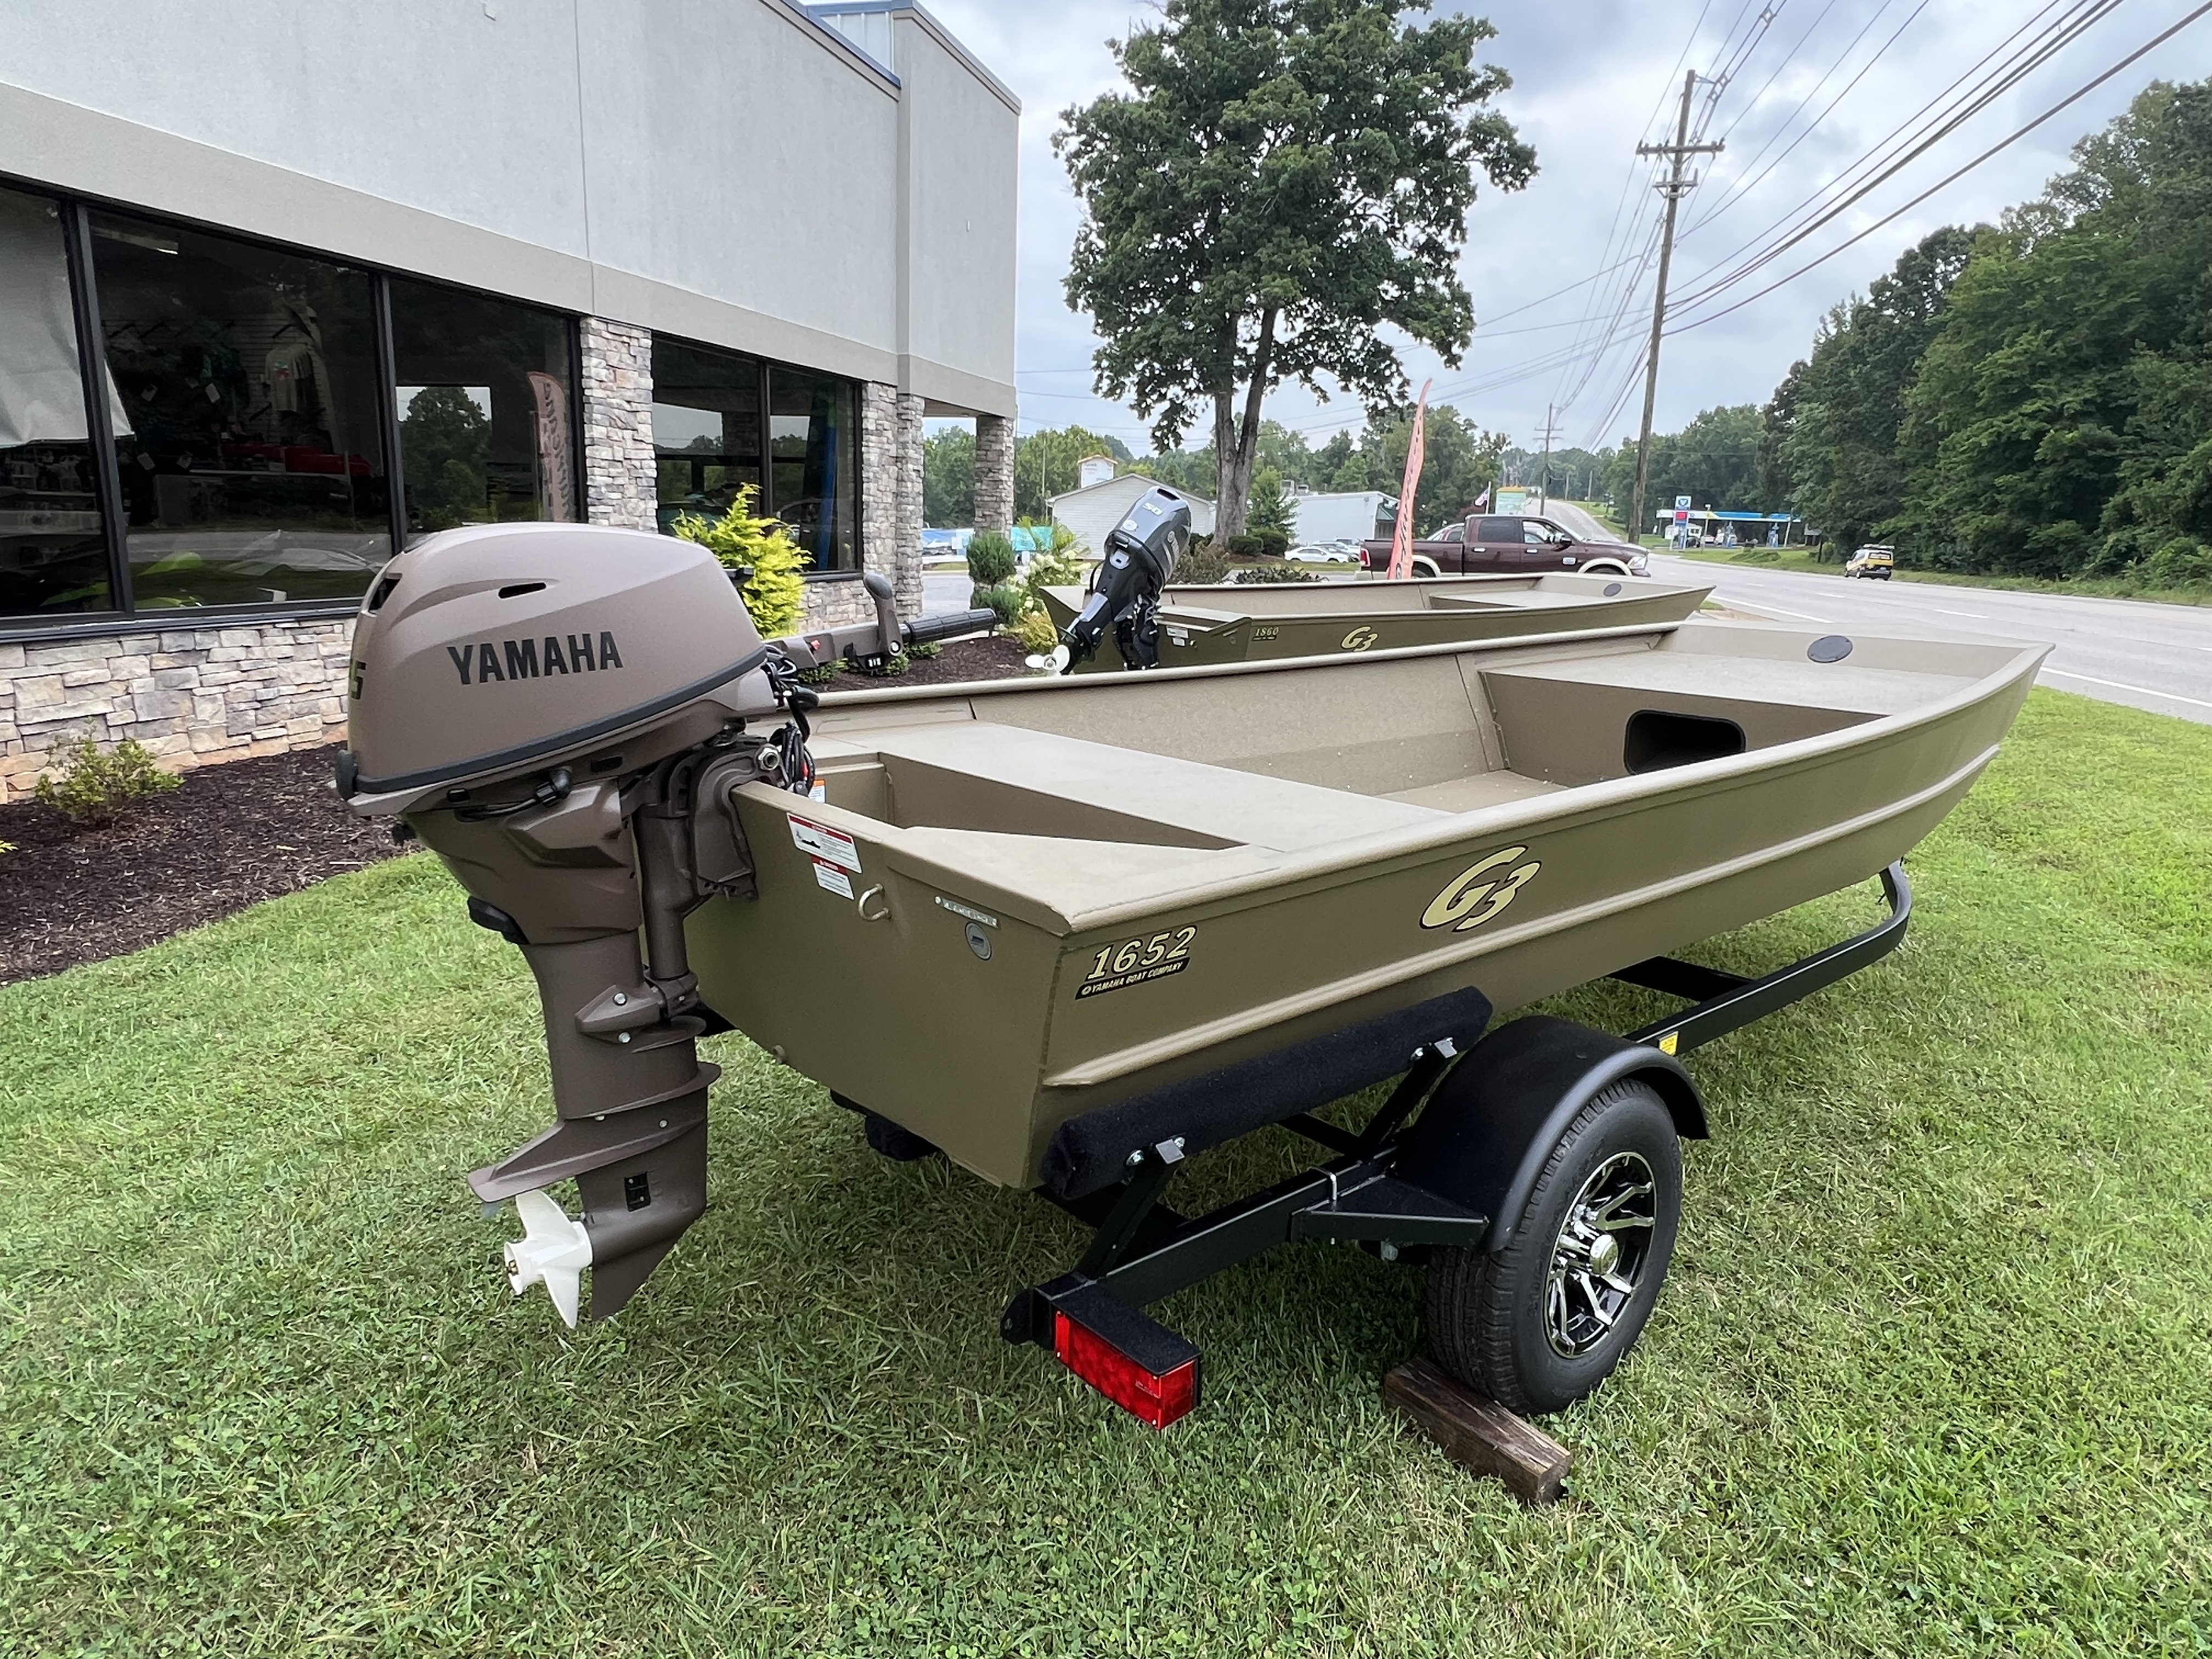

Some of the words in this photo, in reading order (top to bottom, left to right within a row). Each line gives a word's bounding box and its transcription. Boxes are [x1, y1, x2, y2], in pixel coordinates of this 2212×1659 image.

[447, 631, 623, 685] YAMAHA
[1419, 844, 1542, 933] G3
[1085, 924, 1198, 981] 1652
[1092, 978, 1125, 993] YAMAHA
[1126, 971, 1148, 984] BOAT
[1148, 962, 1183, 978] COMPANY
